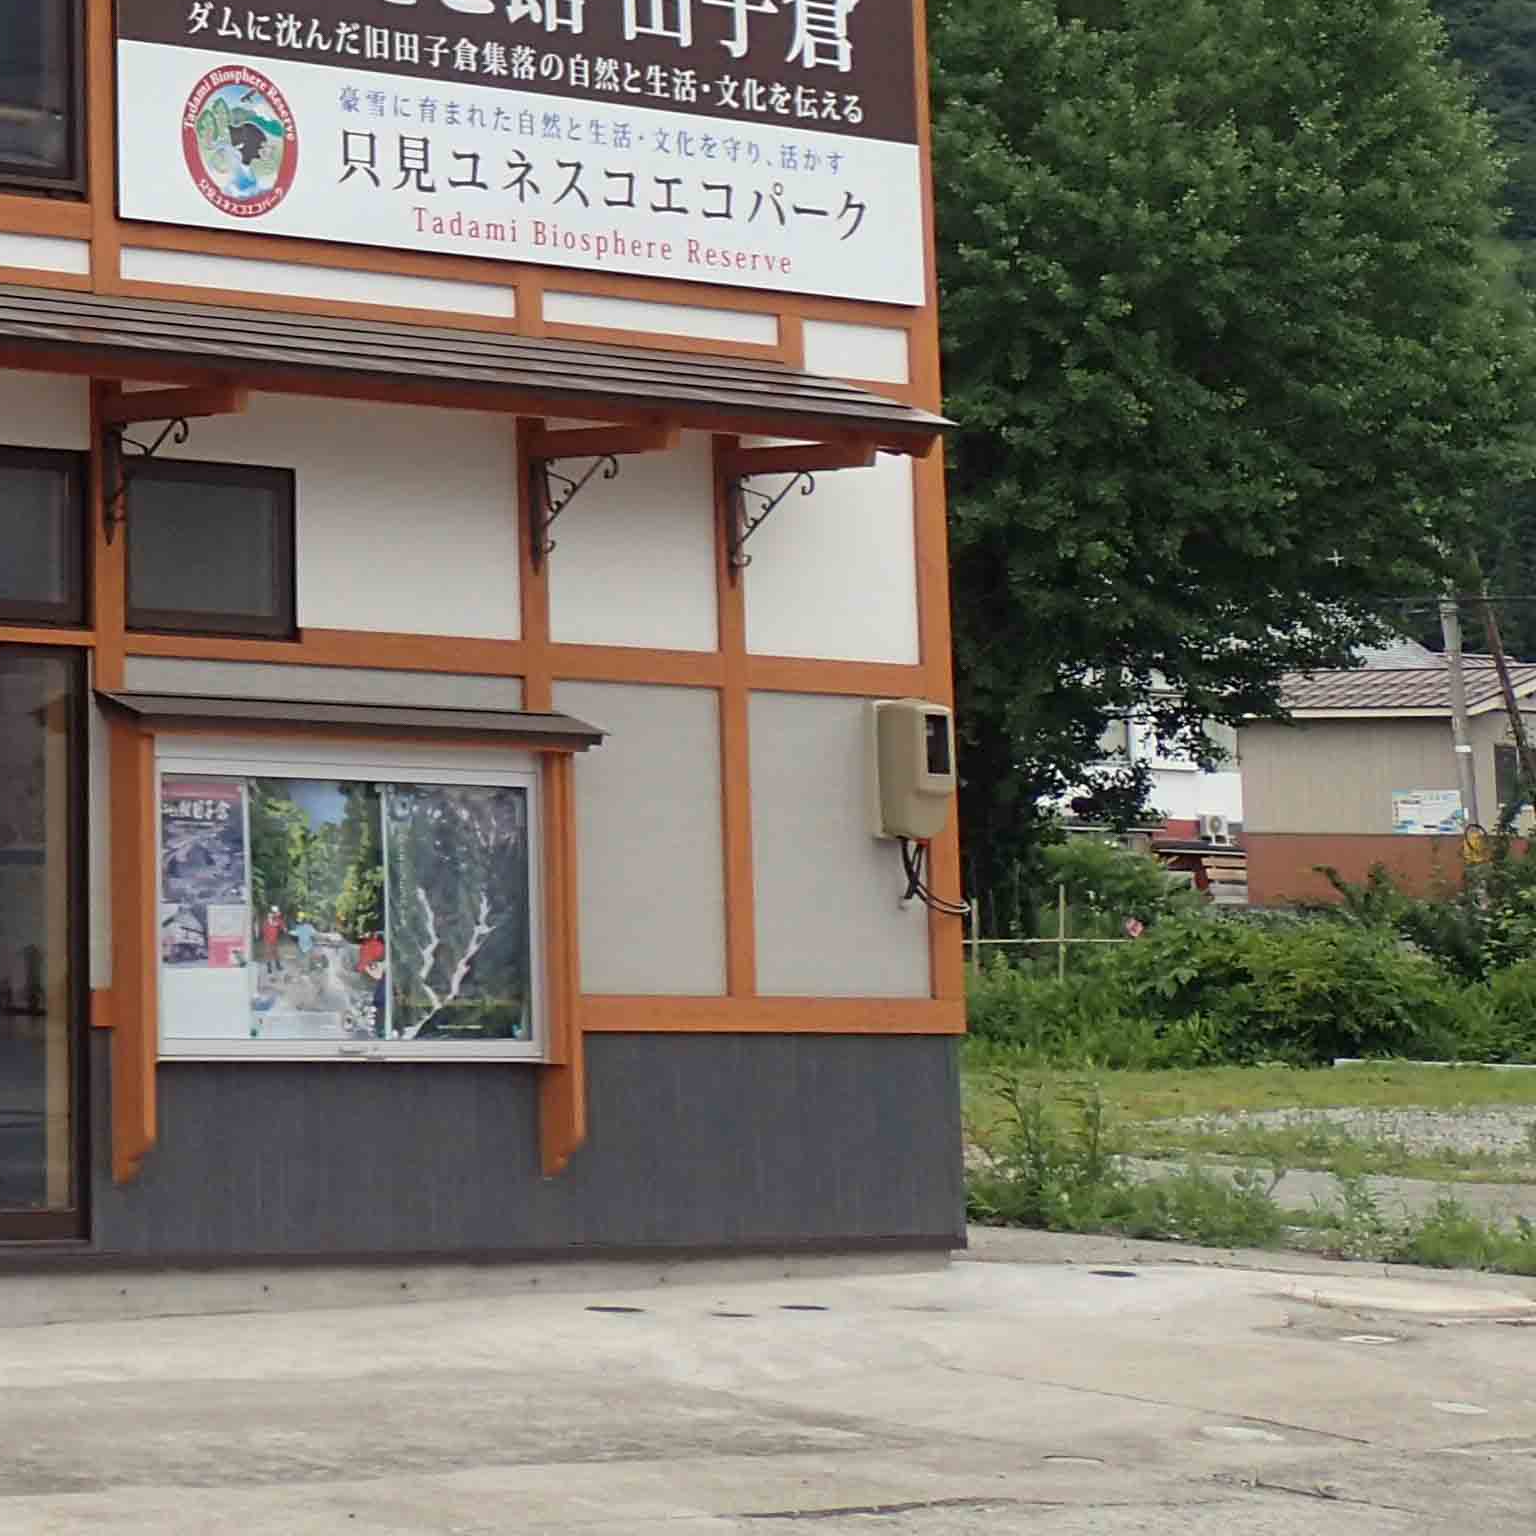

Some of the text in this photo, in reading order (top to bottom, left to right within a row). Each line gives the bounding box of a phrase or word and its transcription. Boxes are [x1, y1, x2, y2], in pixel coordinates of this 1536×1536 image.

[187, 0, 864, 125] ダムに沈んだ旧田子倉集落の自然と生活・文化を伝える
[337, 129, 868, 242] 只見ユネスコエコパーク
[414, 207, 794, 275] Tadami Biosphere Reserve
